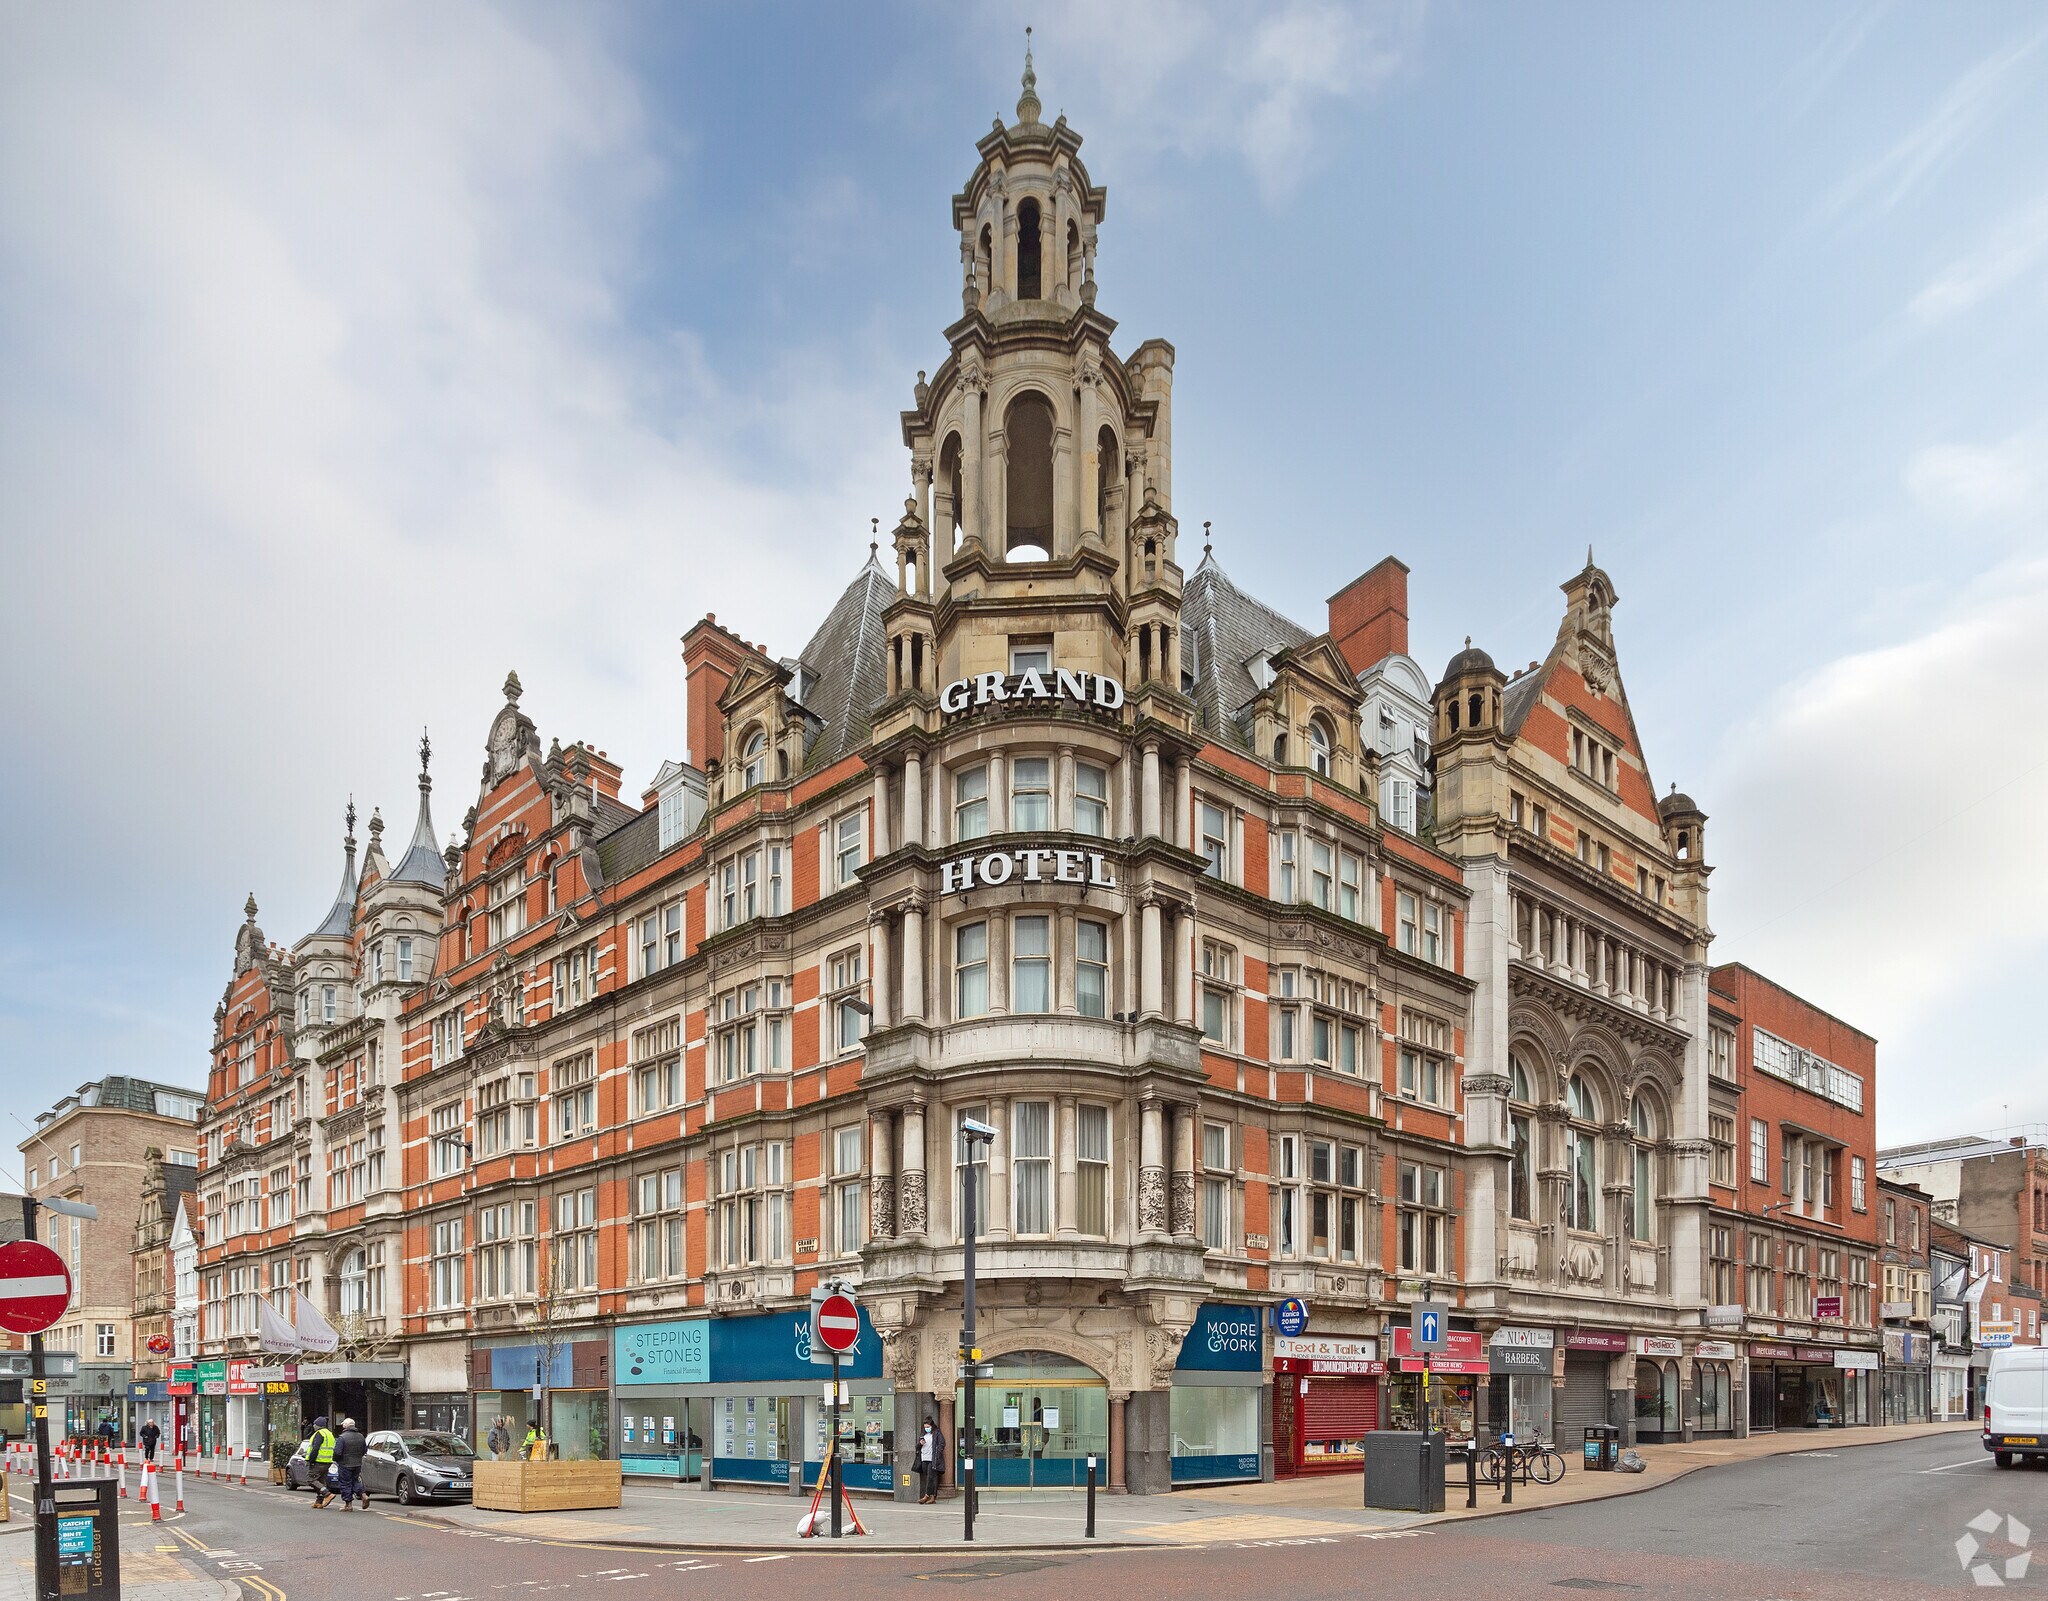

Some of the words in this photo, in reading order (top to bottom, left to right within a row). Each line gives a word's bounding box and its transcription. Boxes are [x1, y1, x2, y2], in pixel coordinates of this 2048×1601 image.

[940, 667, 1124, 714] GRAND
[940, 850, 1116, 895] HOTEL
[1207, 1321, 1256, 1336] MOORE
[300, 1336, 333, 1345] Mercure
[636, 1329, 702, 1347] STEPPING
[1222, 1338, 1257, 1352] YORK
[1566, 1336, 1587, 1344] DELIVERY
[1587, 1337, 1609, 1346] ENTRANCE
[1649, 1340, 1661, 1348] Red
[1661, 1341, 1676, 1350] Rock
[1287, 1341, 1315, 1353] Text
[1319, 1343, 1330, 1354] &
[1333, 1343, 1361, 1355] Talk
[648, 1348, 702, 1364] STONES
[1505, 1352, 1540, 1364] BARBERS
[663, 1367, 682, 1375] Financial
[682, 1366, 702, 1375] Planning
[1282, 1360, 1288, 1371] 2
[38, 1407, 45, 1416] 7
[92, 1528, 103, 1586] Leicester
